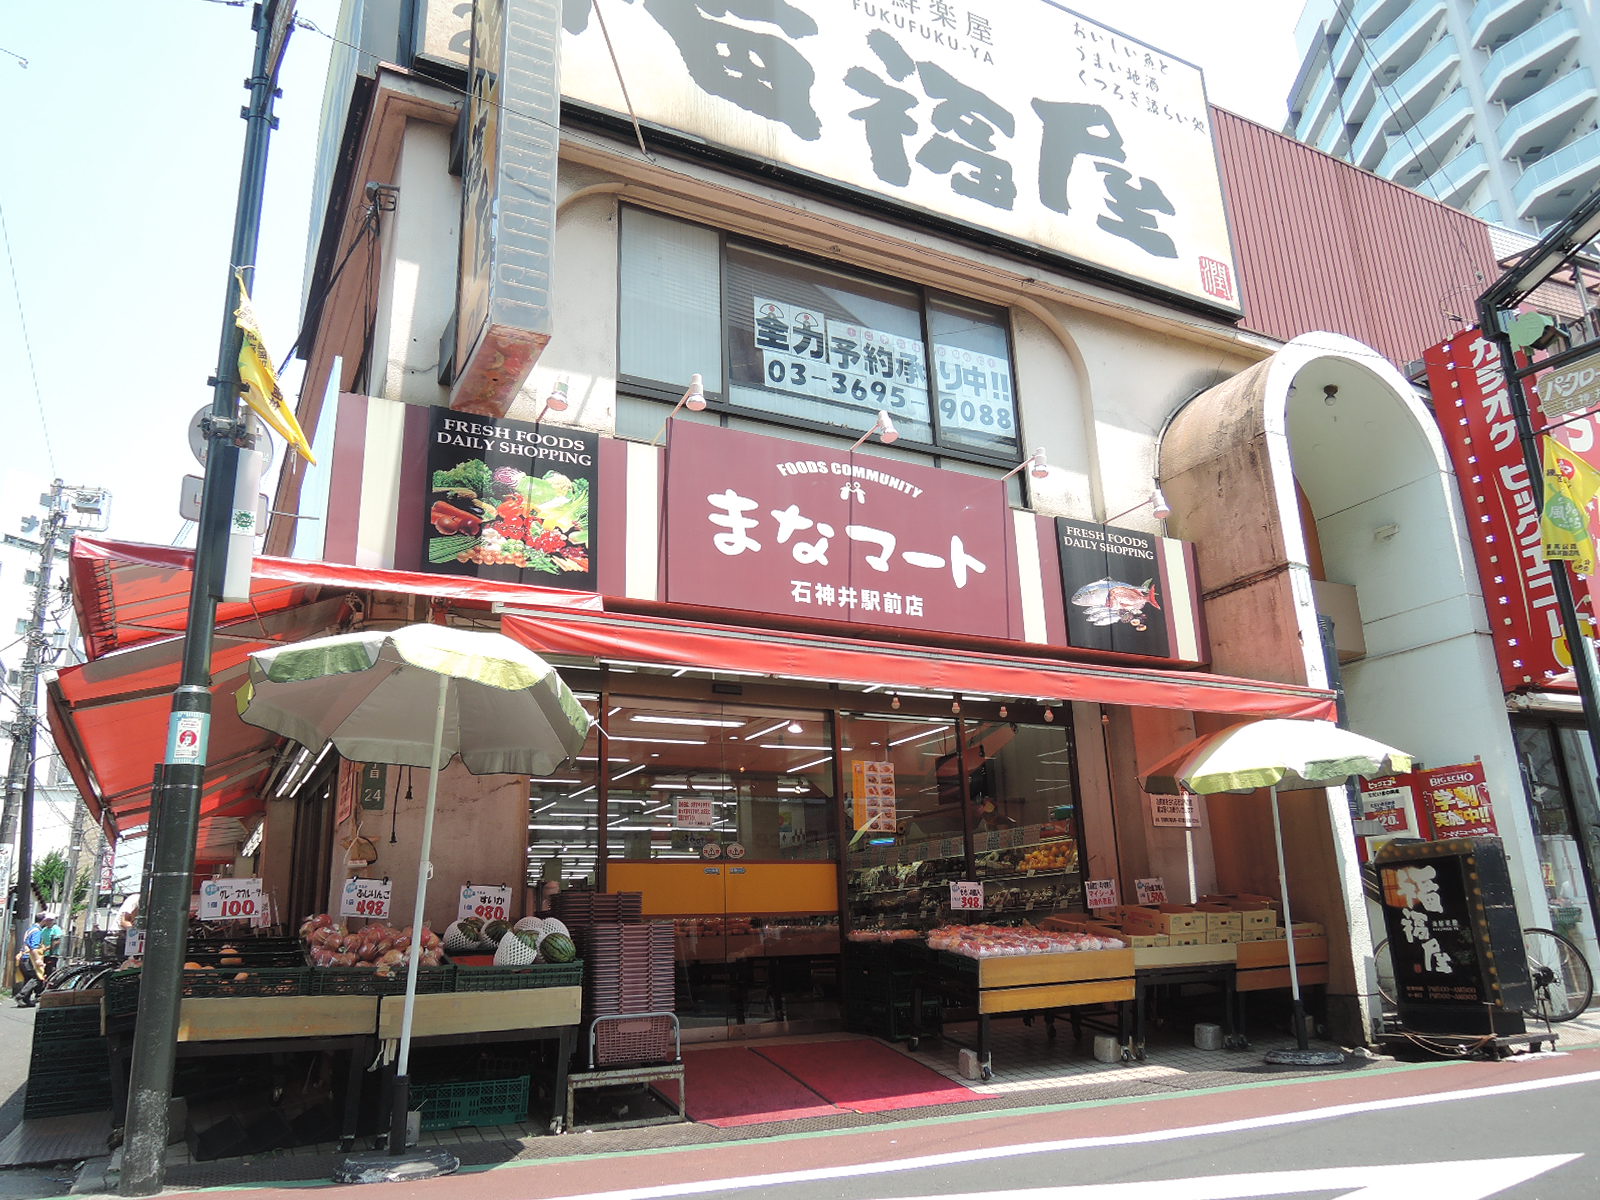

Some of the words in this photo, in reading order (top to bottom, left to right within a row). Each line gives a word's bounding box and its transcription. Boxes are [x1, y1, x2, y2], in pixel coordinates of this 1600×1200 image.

[852, 0, 994, 65] FUKUFUKU-YA
[768, 360, 1012, 429] 03-3695-9088
[437, 431, 494, 452] DAILY
[499, 440, 592, 467] SHOPPING
[443, 418, 510, 440] FRESH
[515, 430, 585, 452] FOODS
[776, 460, 829, 477] FOODS
[830, 461, 923, 499] COMMUNITY
[706, 488, 987, 589] まなマート
[1064, 536, 1099, 551] DAILY
[1100, 542, 1155, 560] SHOPPING
[1066, 526, 1104, 541] FRESH
[1107, 533, 1149, 550] FOODS
[790, 580, 924, 617] 石神井駅前店
[364, 788, 382, 802] 24
[1447, 772, 1474, 783] ECHO
[1433, 785, 1479, 811] 学割
